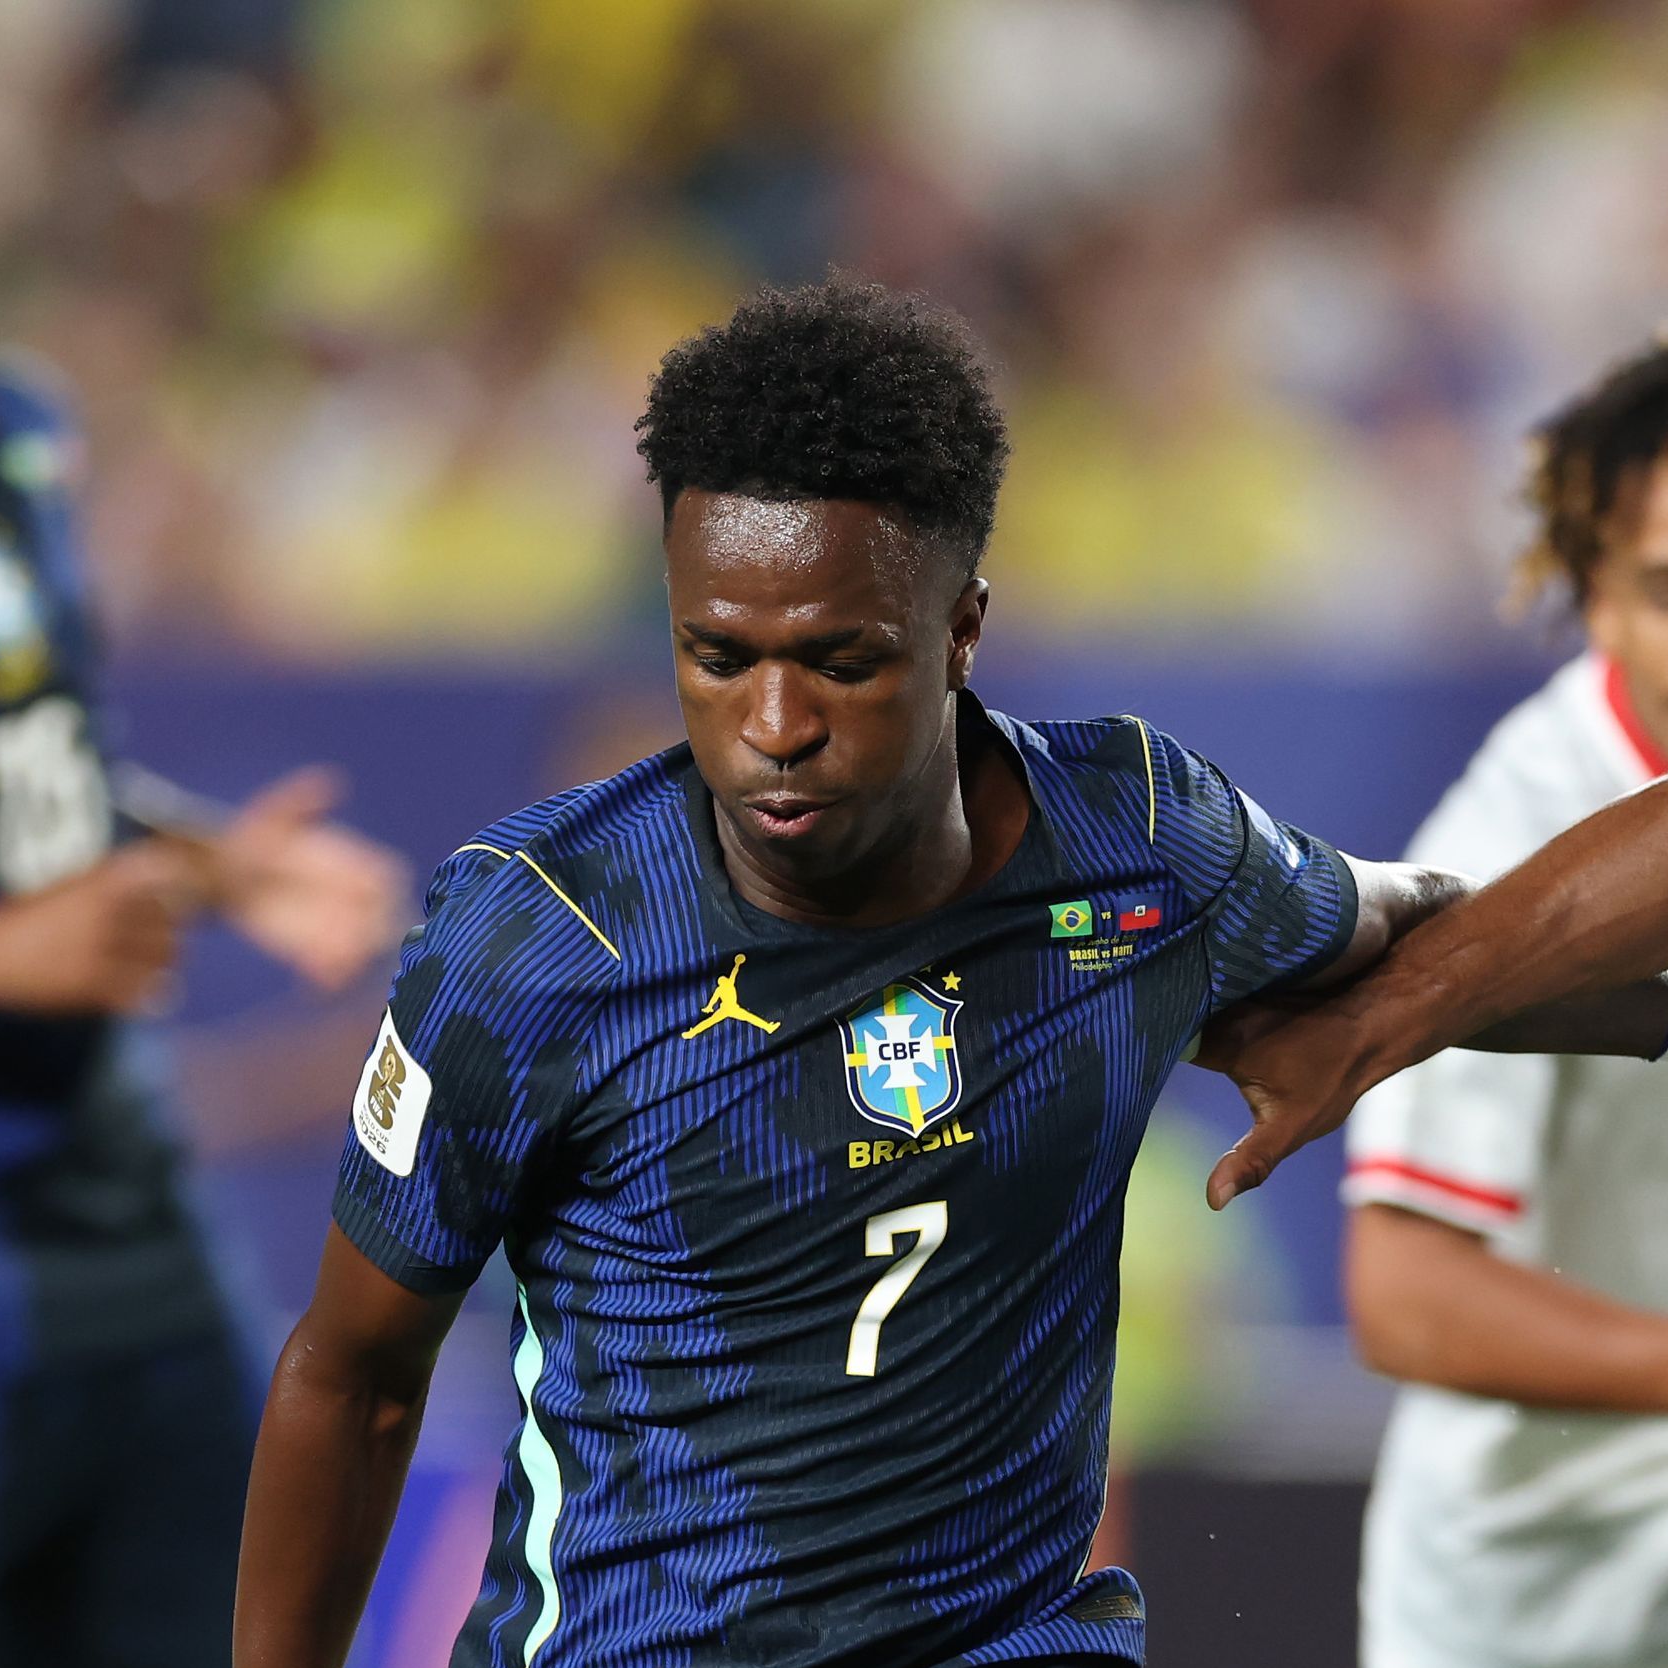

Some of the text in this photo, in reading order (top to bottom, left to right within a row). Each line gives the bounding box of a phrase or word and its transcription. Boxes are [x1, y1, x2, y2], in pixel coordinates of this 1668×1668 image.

[878, 1041, 921, 1061] CBF
[848, 1116, 974, 1169] BRASIL
[845, 1200, 948, 1377] 7
